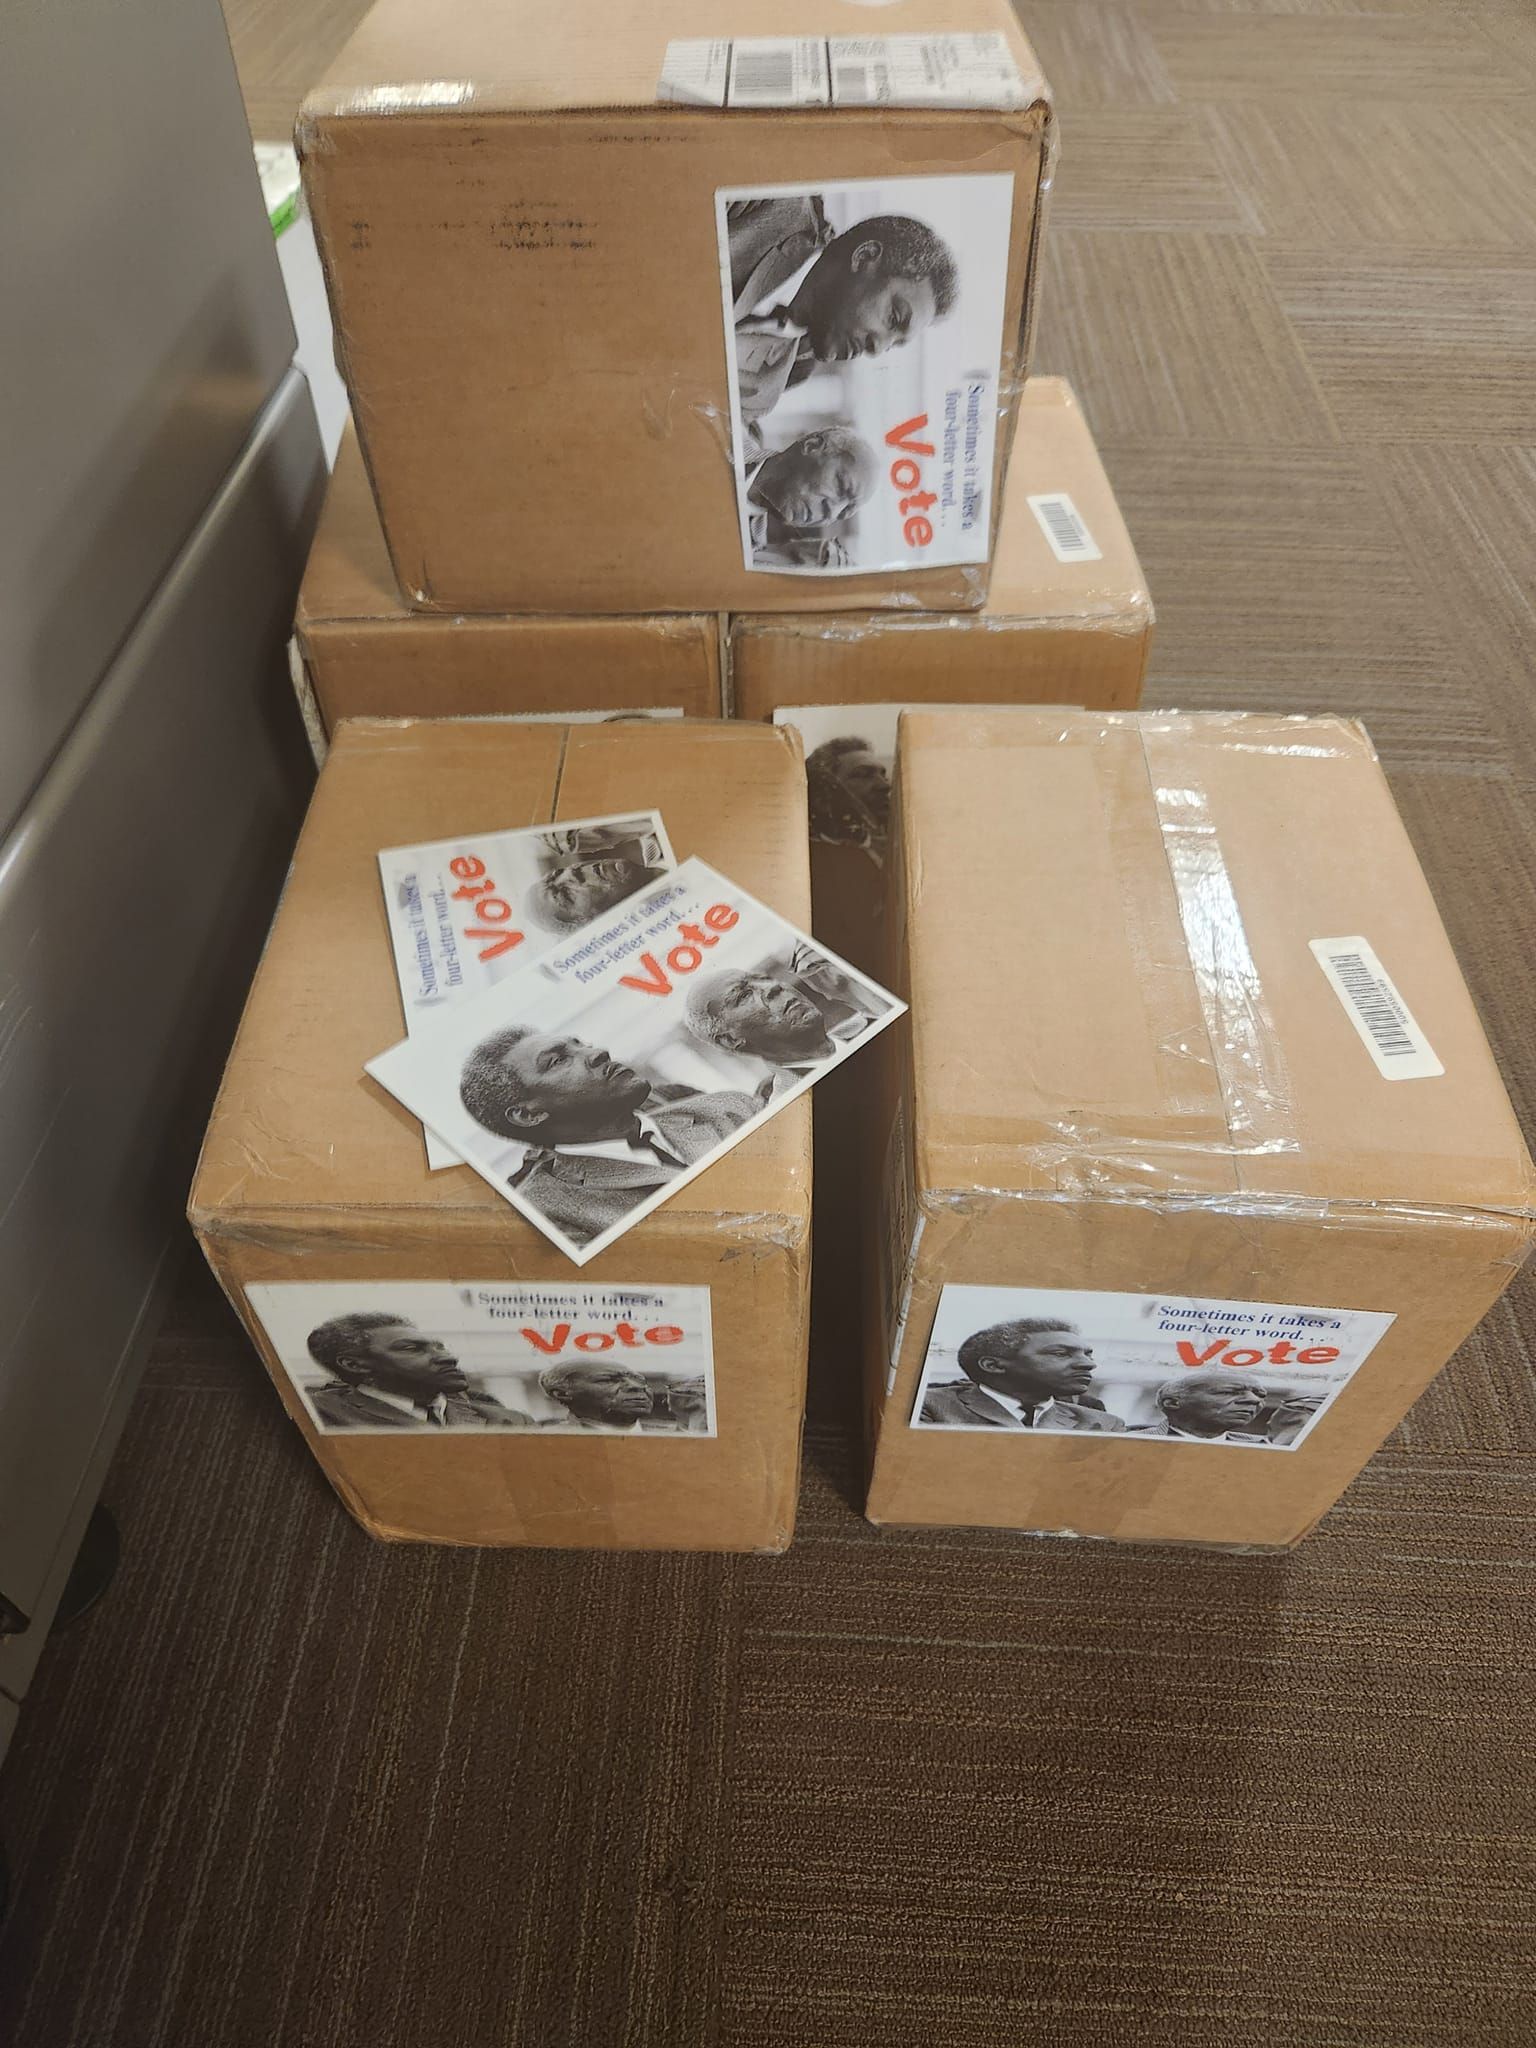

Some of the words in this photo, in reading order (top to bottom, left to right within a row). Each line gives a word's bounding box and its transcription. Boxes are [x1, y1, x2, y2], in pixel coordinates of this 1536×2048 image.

[884, 413, 938, 547] Vote
[449, 855, 524, 964] Vote
[553, 922, 629, 973] Sometimes
[624, 912, 641, 926] it
[674, 886, 686, 896] a
[575, 936, 645, 983] four-letter
[617, 903, 740, 997] Vote
[478, 1292, 577, 1306] Sometimes
[583, 1294, 594, 1306] it
[488, 1307, 580, 1319] four-letter
[1157, 1305, 1255, 1324] Sometimes
[1259, 1313, 1273, 1325] it
[1279, 1314, 1324, 1329] takes
[1329, 1320, 1343, 1330] a
[1157, 1320, 1251, 1336] four-letter
[519, 1322, 684, 1355] Vote
[1176, 1339, 1340, 1368] Vote
